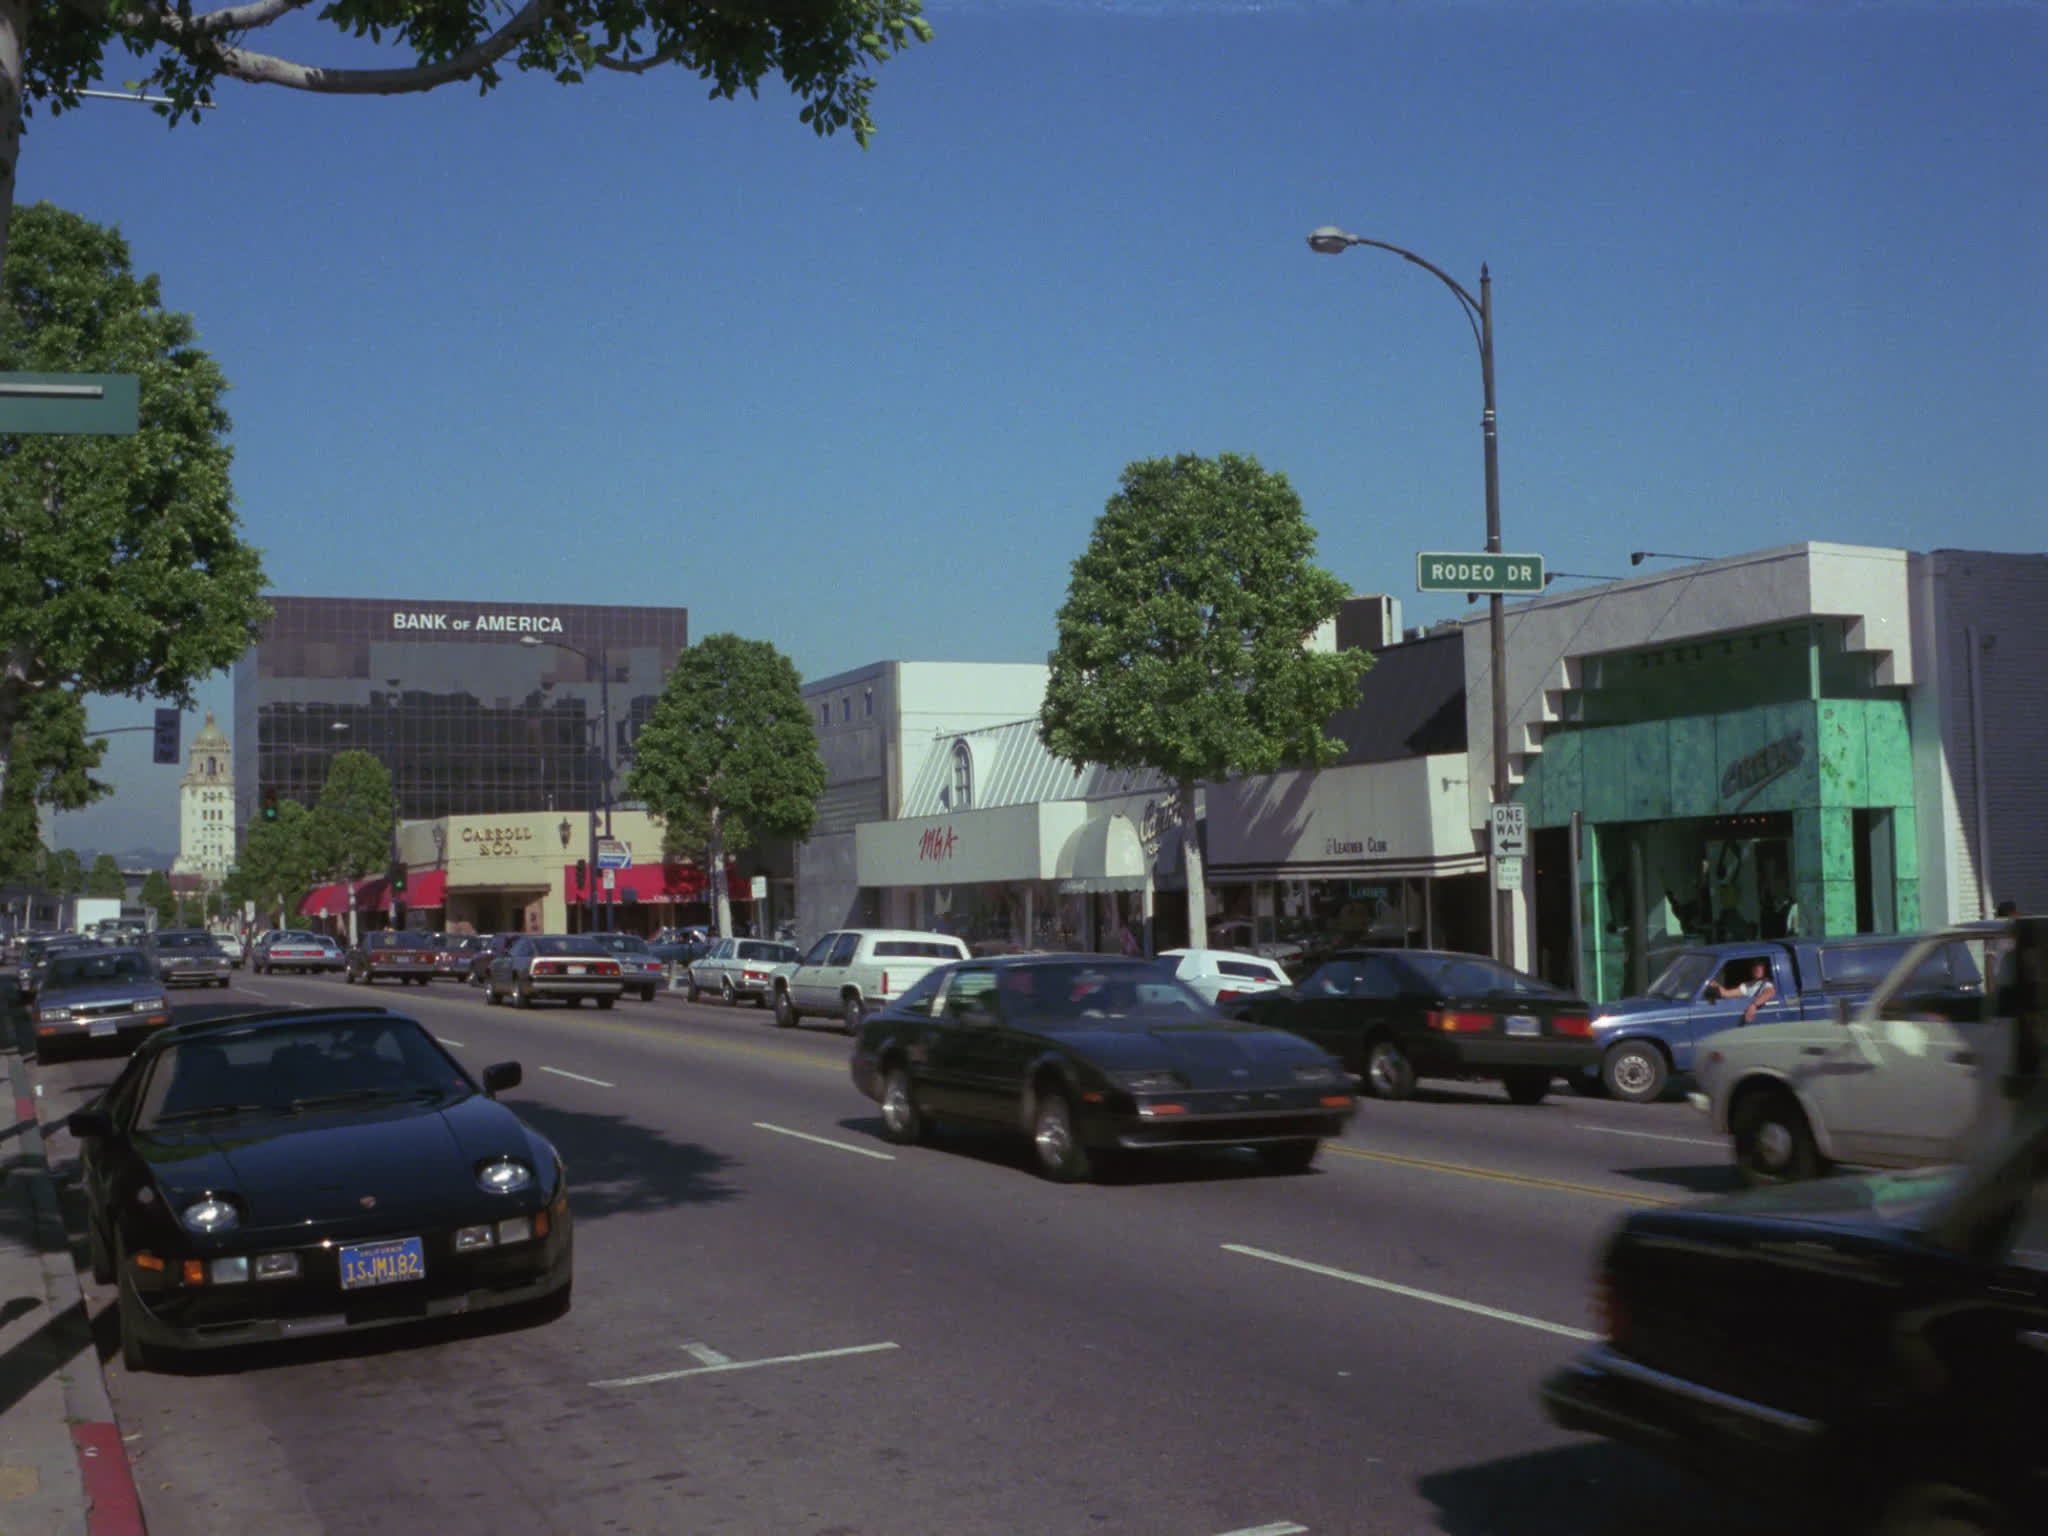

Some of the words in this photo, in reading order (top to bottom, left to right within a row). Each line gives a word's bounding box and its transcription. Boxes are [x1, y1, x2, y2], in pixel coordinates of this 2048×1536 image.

[1432, 564, 1495, 581] RODEO
[1507, 565, 1533, 581] DR
[393, 613, 447, 630] BANK
[453, 620, 471, 630] OF
[475, 615, 563, 632] AMERICA
[1496, 809, 1522, 822] ONE
[463, 827, 532, 842] CARROLL
[1496, 823, 1522, 836] WAY
